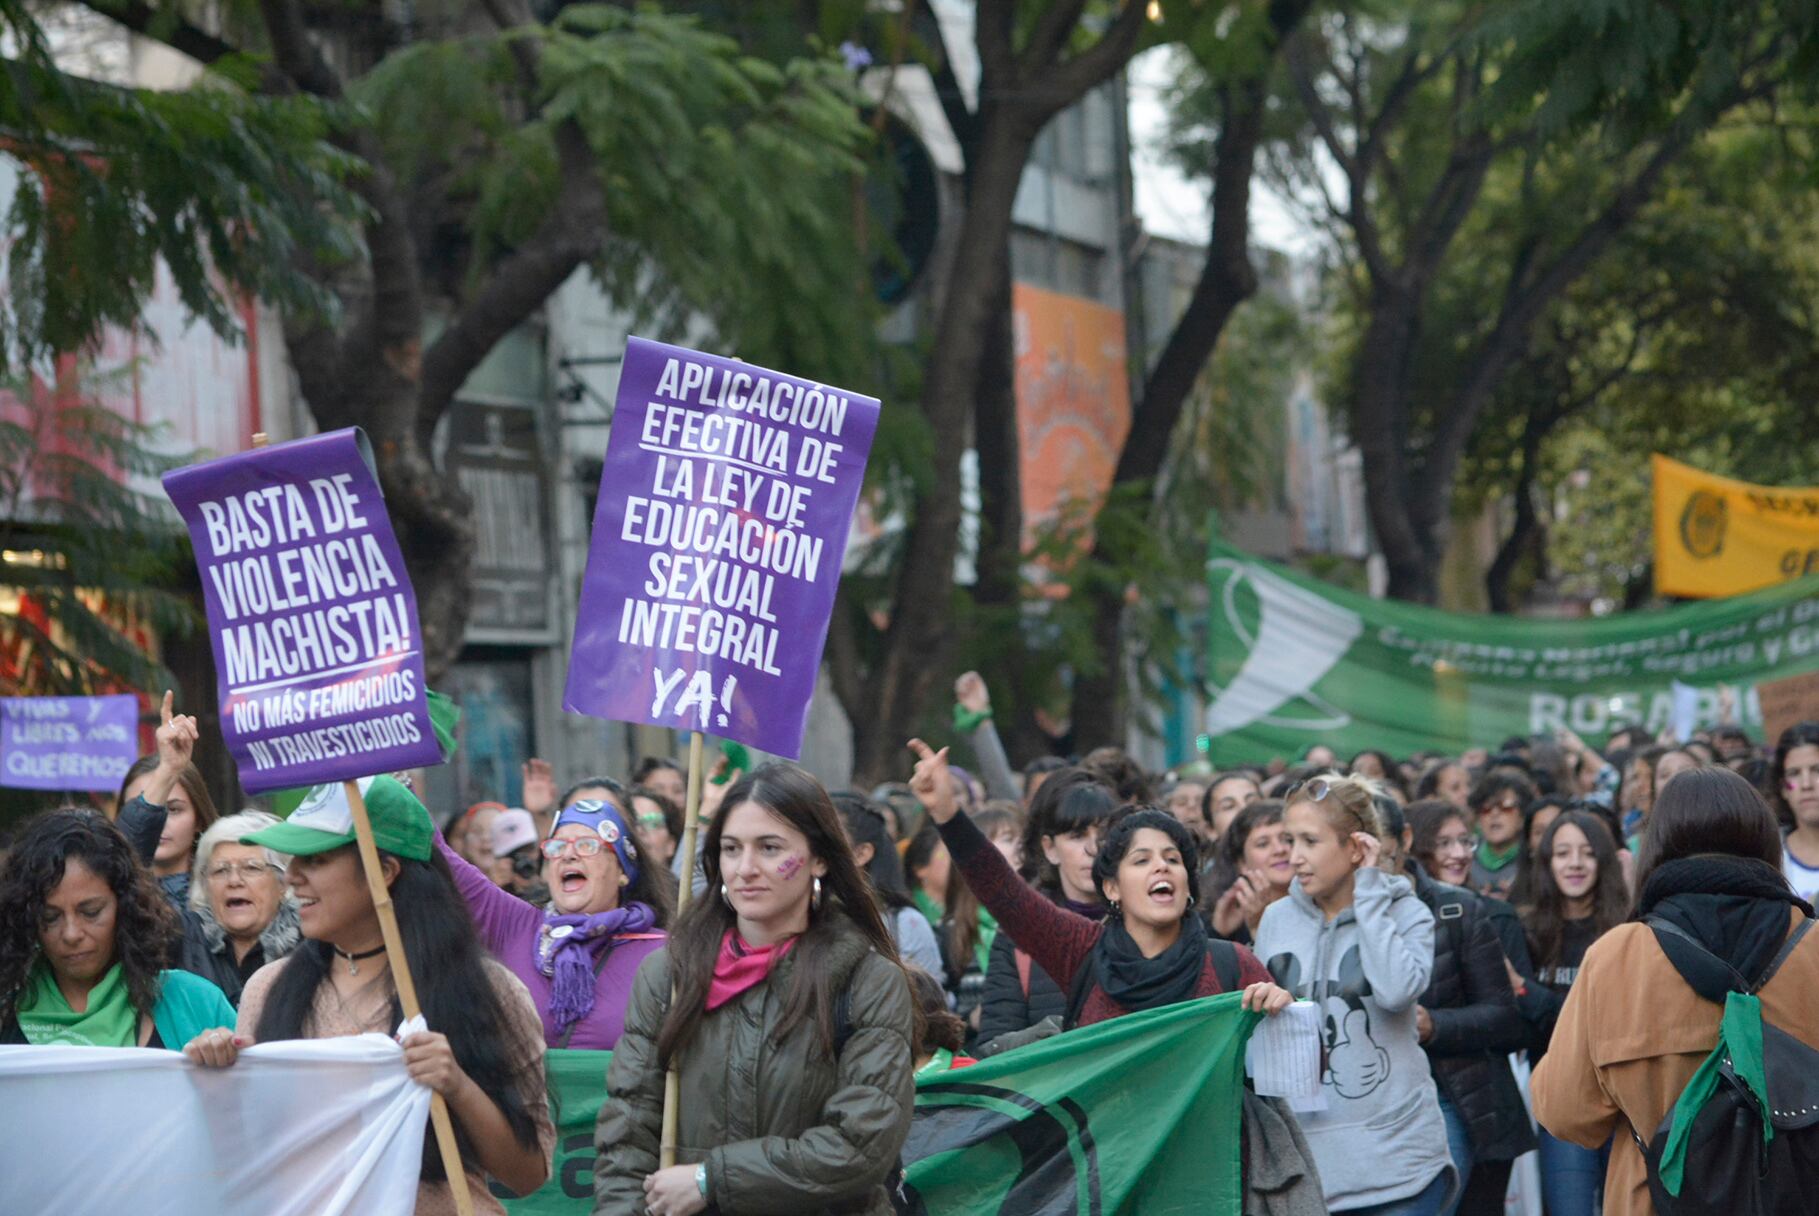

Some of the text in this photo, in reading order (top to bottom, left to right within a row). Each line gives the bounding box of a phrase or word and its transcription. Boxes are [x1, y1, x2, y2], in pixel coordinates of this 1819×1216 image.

[655, 358, 848, 437] APLICACIÓN
[641, 402, 843, 484] EFECTIVA DE
[198, 473, 368, 557] BASTA DE
[652, 455, 812, 528] LA LEY DE
[208, 533, 398, 620] VIOLENCIA
[621, 495, 824, 582] EDUCACIÓN
[644, 551, 777, 623] SEXUAL
[221, 593, 412, 685] MACHISTA!
[618, 598, 782, 677] INTEGRAL
[232, 668, 416, 735] NO MÁS FEMICIDIOS
[651, 666, 738, 728] YA!
[6, 750, 131, 778] QUEREMOS
[246, 711, 421, 770] NI TRAVESTICIDIOS
